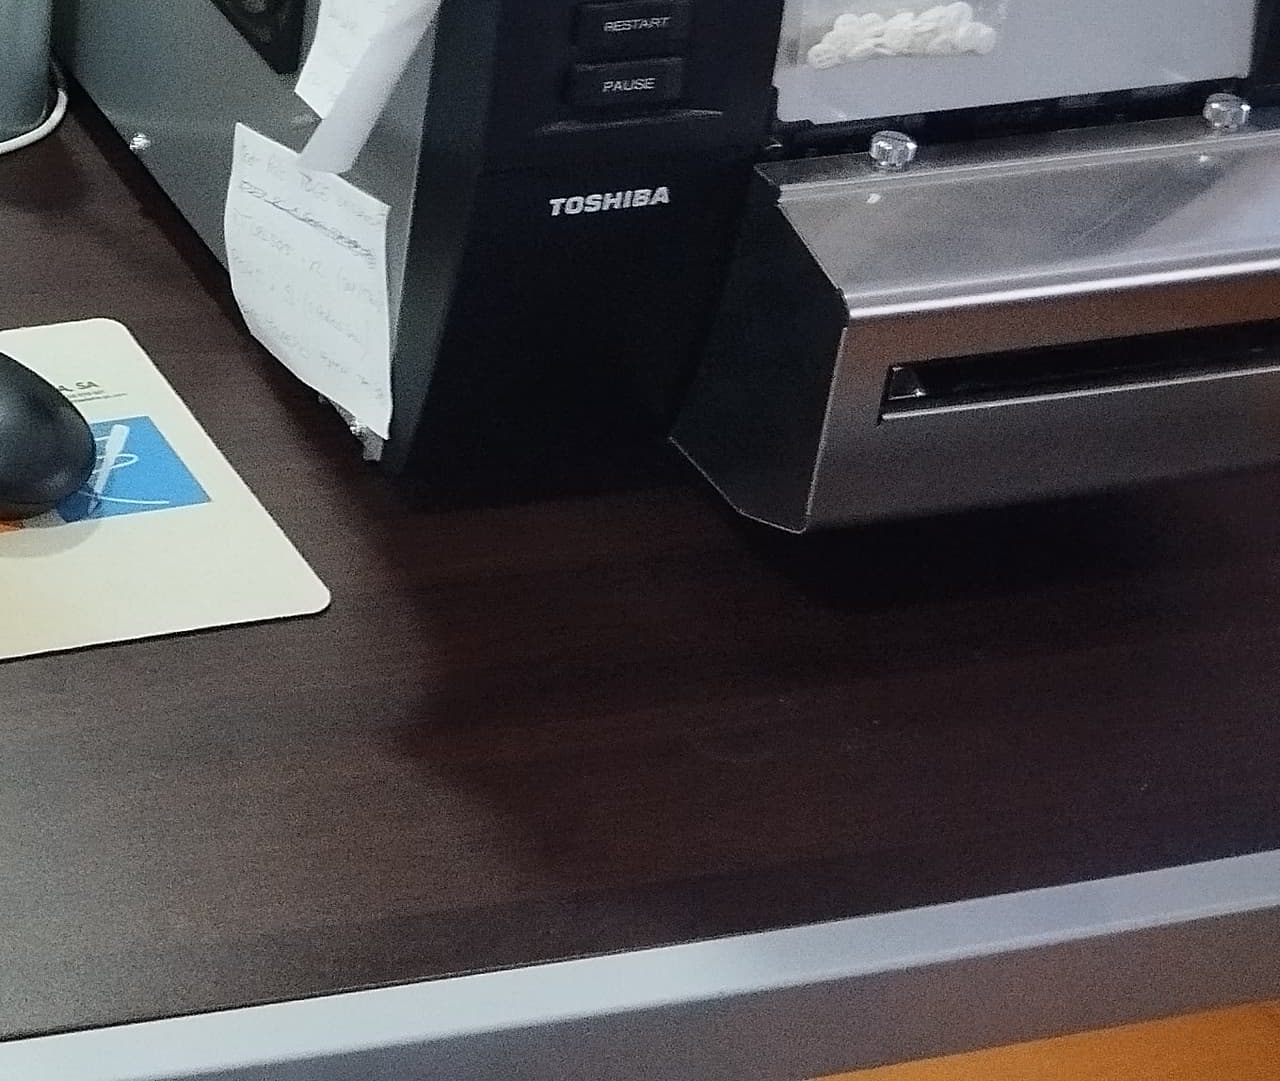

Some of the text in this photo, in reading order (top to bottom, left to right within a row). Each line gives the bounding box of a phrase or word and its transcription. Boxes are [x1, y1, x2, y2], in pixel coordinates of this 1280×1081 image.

[603, 16, 671, 33] RESTART
[603, 77, 656, 93] PAUSE
[549, 186, 671, 217] TOSHIBA
